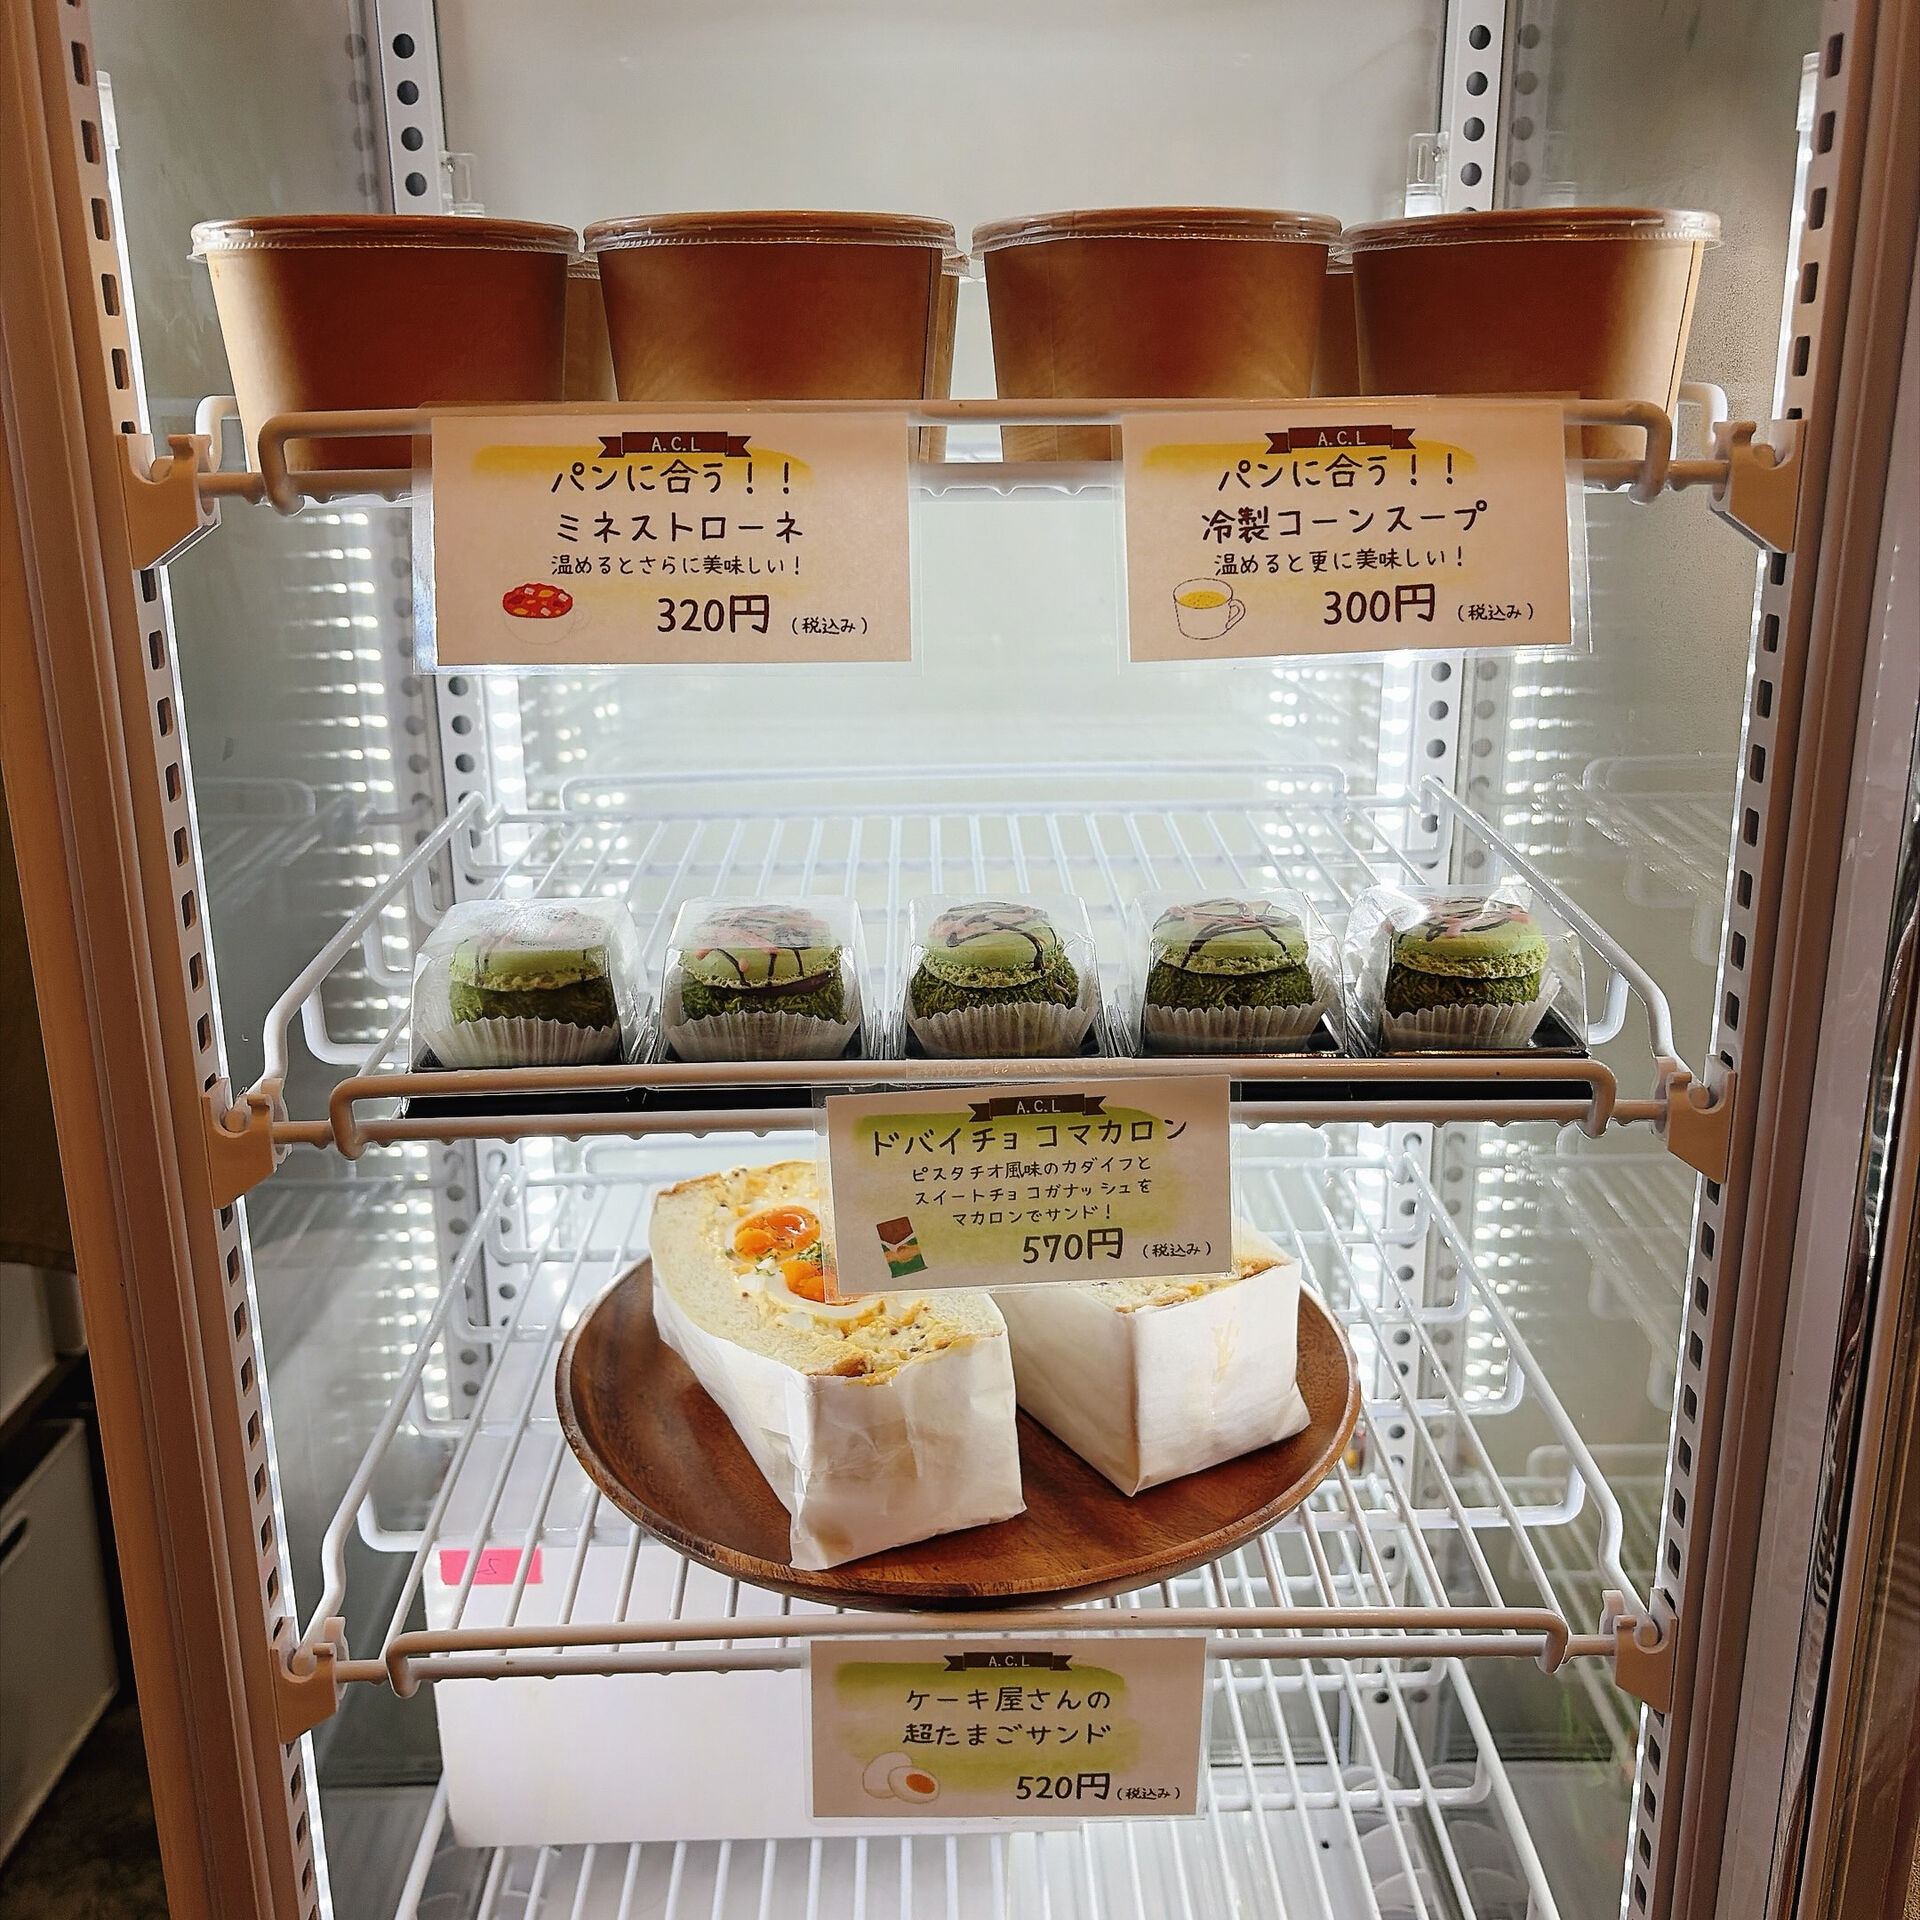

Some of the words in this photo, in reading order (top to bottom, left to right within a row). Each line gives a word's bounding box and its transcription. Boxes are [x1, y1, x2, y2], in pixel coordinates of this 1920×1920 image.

[555, 510, 804, 544] ミネストローネ
[1200, 499, 1489, 544] 冷製コーンスープ
[655, 593, 770, 635] 320円
[1323, 582, 1437, 626] 300円
[911, 1155, 1153, 1183] ピスタチオ風味のカダイフと
[1022, 1227, 1124, 1264] 570円
[906, 1686, 1112, 1712] ケーキ屋さんの
[902, 1722, 1112, 1746] 超たまごサンド
[1016, 1773, 1110, 1800] 520円
